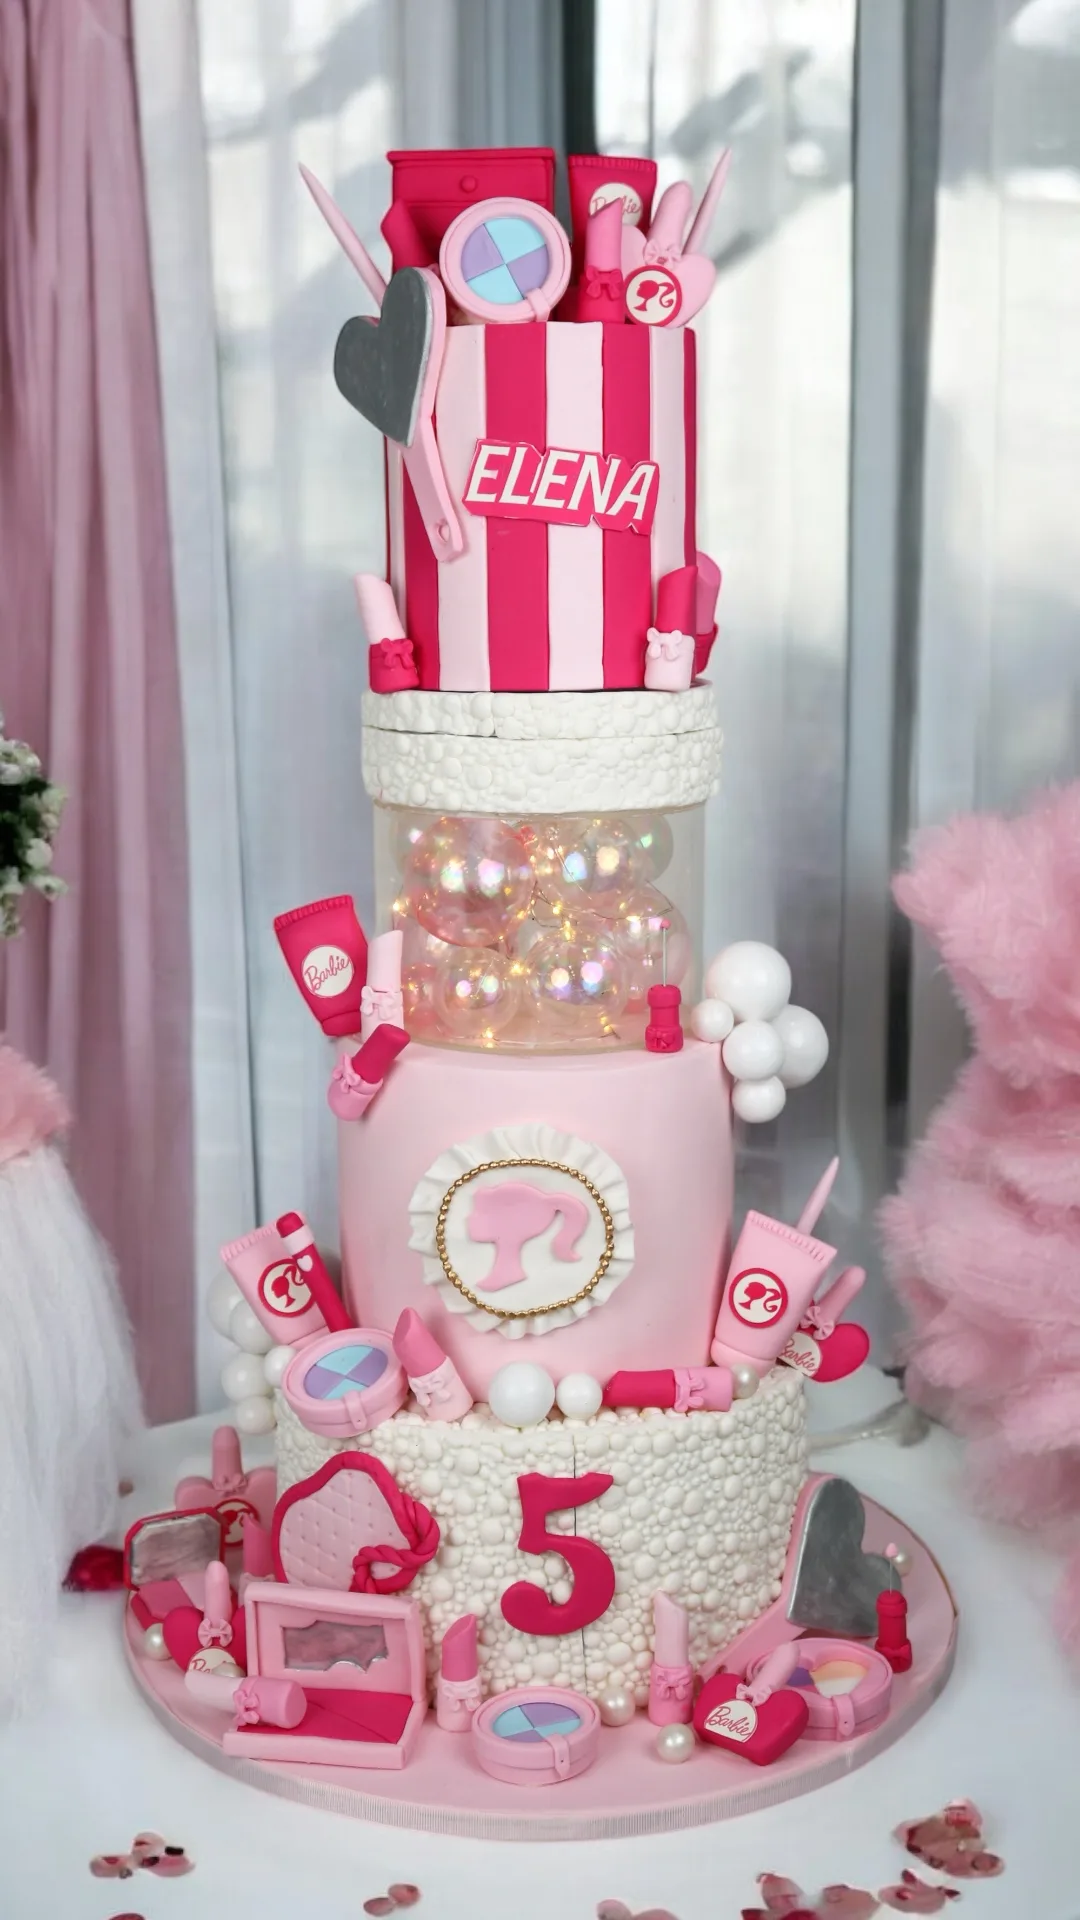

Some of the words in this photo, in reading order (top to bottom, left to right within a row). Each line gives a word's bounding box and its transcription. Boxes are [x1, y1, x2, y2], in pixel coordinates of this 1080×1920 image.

[465, 445, 656, 520] ELENA
[305, 955, 350, 992] Barbie
[501, 1472, 615, 1636] 5
[706, 1706, 752, 1736] Barbie
